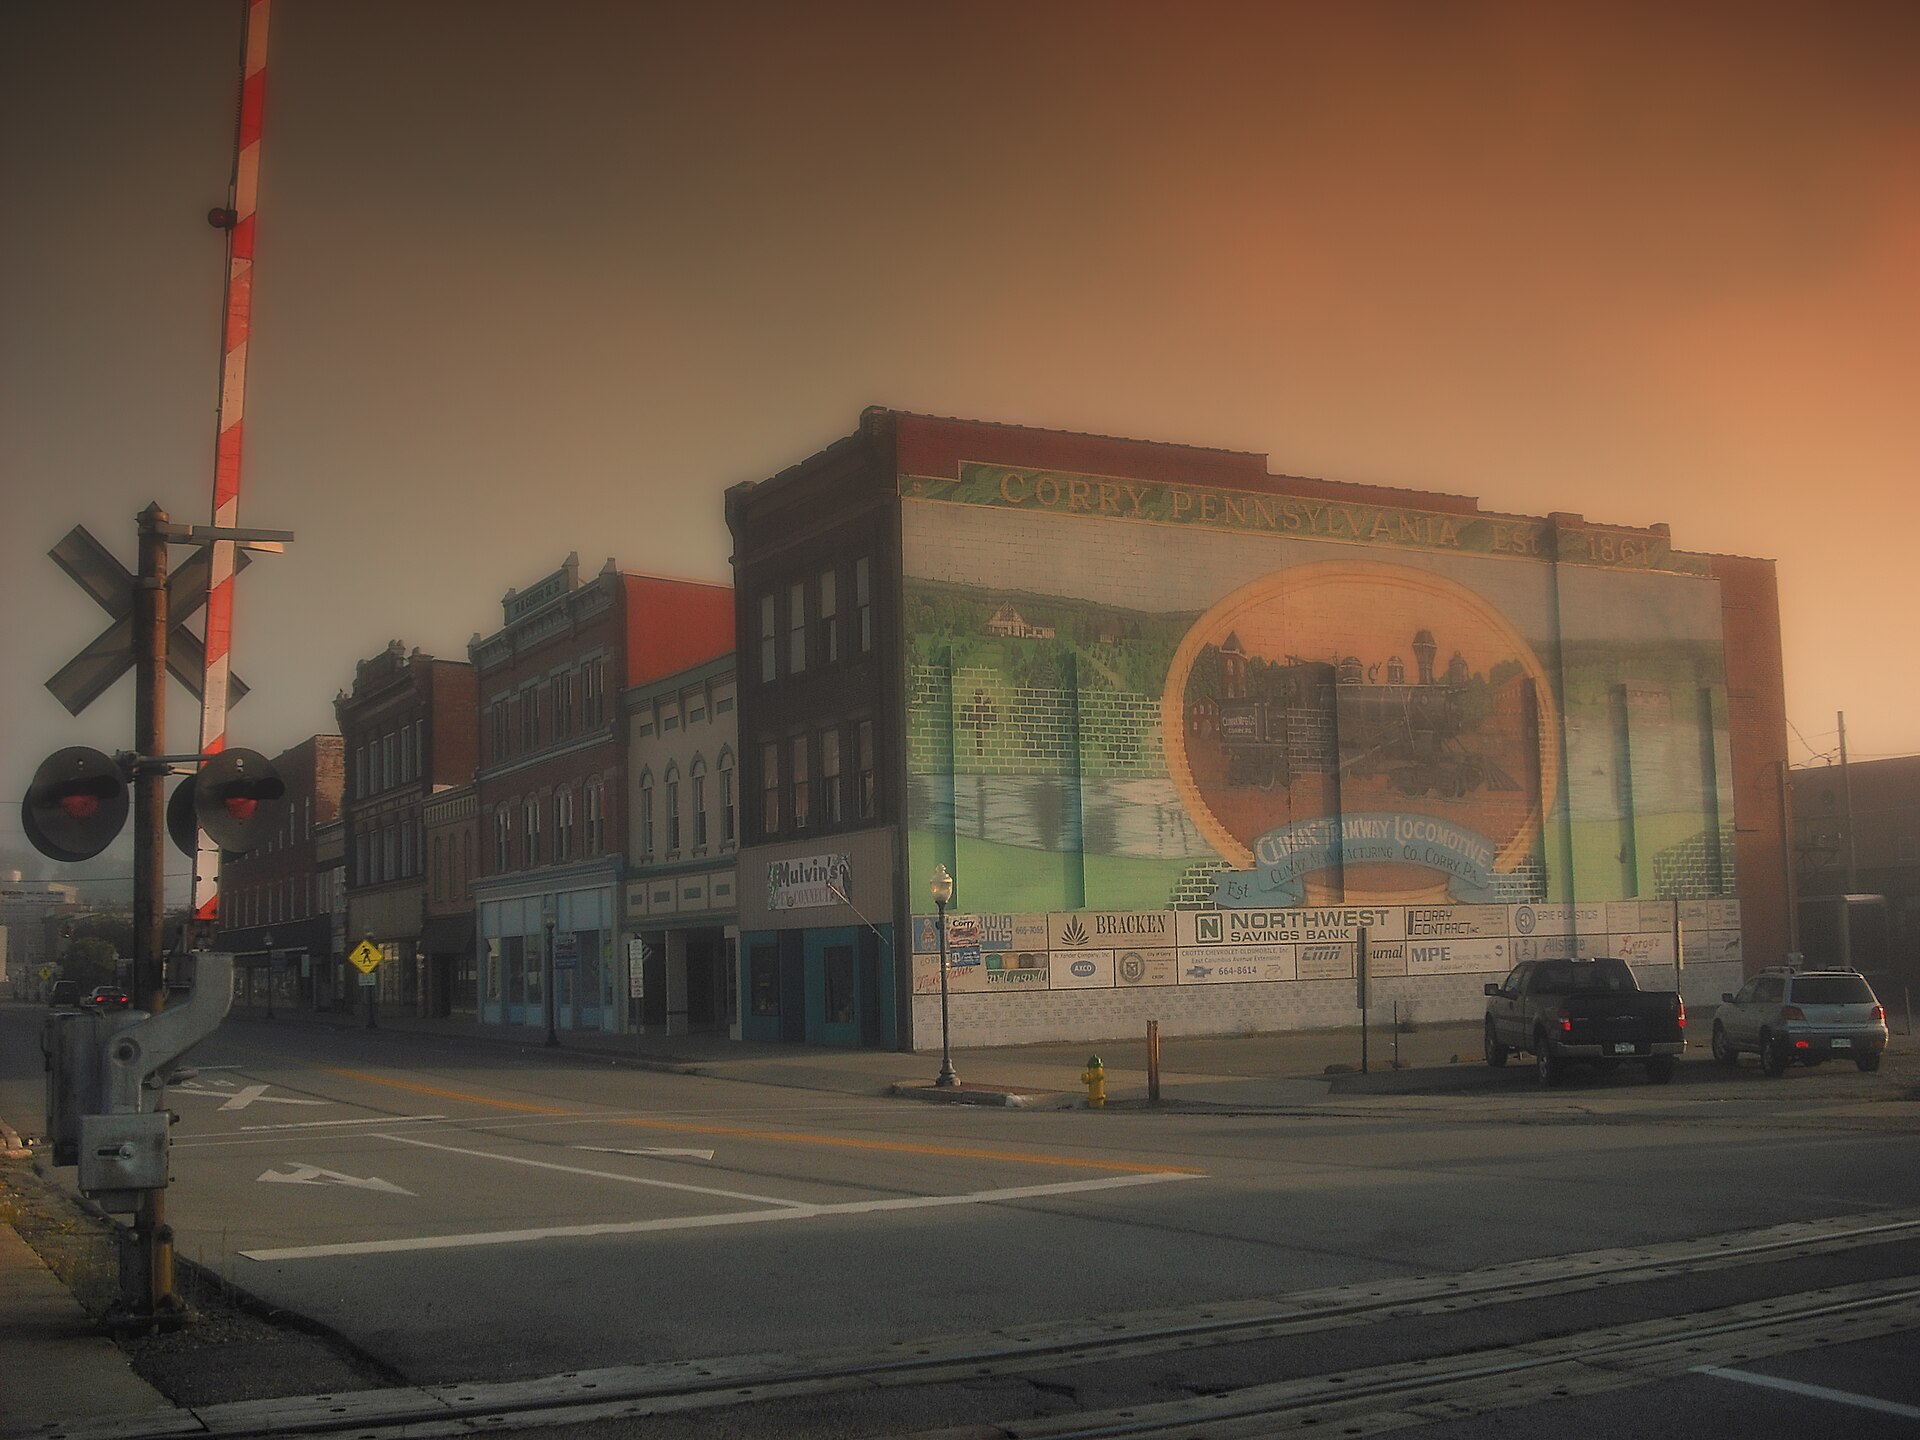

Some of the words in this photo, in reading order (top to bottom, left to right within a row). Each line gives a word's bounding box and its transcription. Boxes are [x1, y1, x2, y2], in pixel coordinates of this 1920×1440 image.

[1171, 490, 1459, 546] PENNSYLVANIA
[1395, 816, 1490, 867] LOCOMOTIVE
[778, 856, 838, 887] Mulvin's
[1231, 910, 1389, 929] NORTHWEST
[1415, 910, 1452, 921] CORRY
[1537, 910, 1556, 920] ERIE
[1096, 914, 1166, 934] BRACKEN
[1414, 922, 1471, 935] CONTRACT
[1231, 930, 1299, 942] SAVINGS
[1306, 929, 1349, 939] BANK
[1411, 947, 1451, 962] MPE
[1218, 966, 1257, 975] 664-8614
